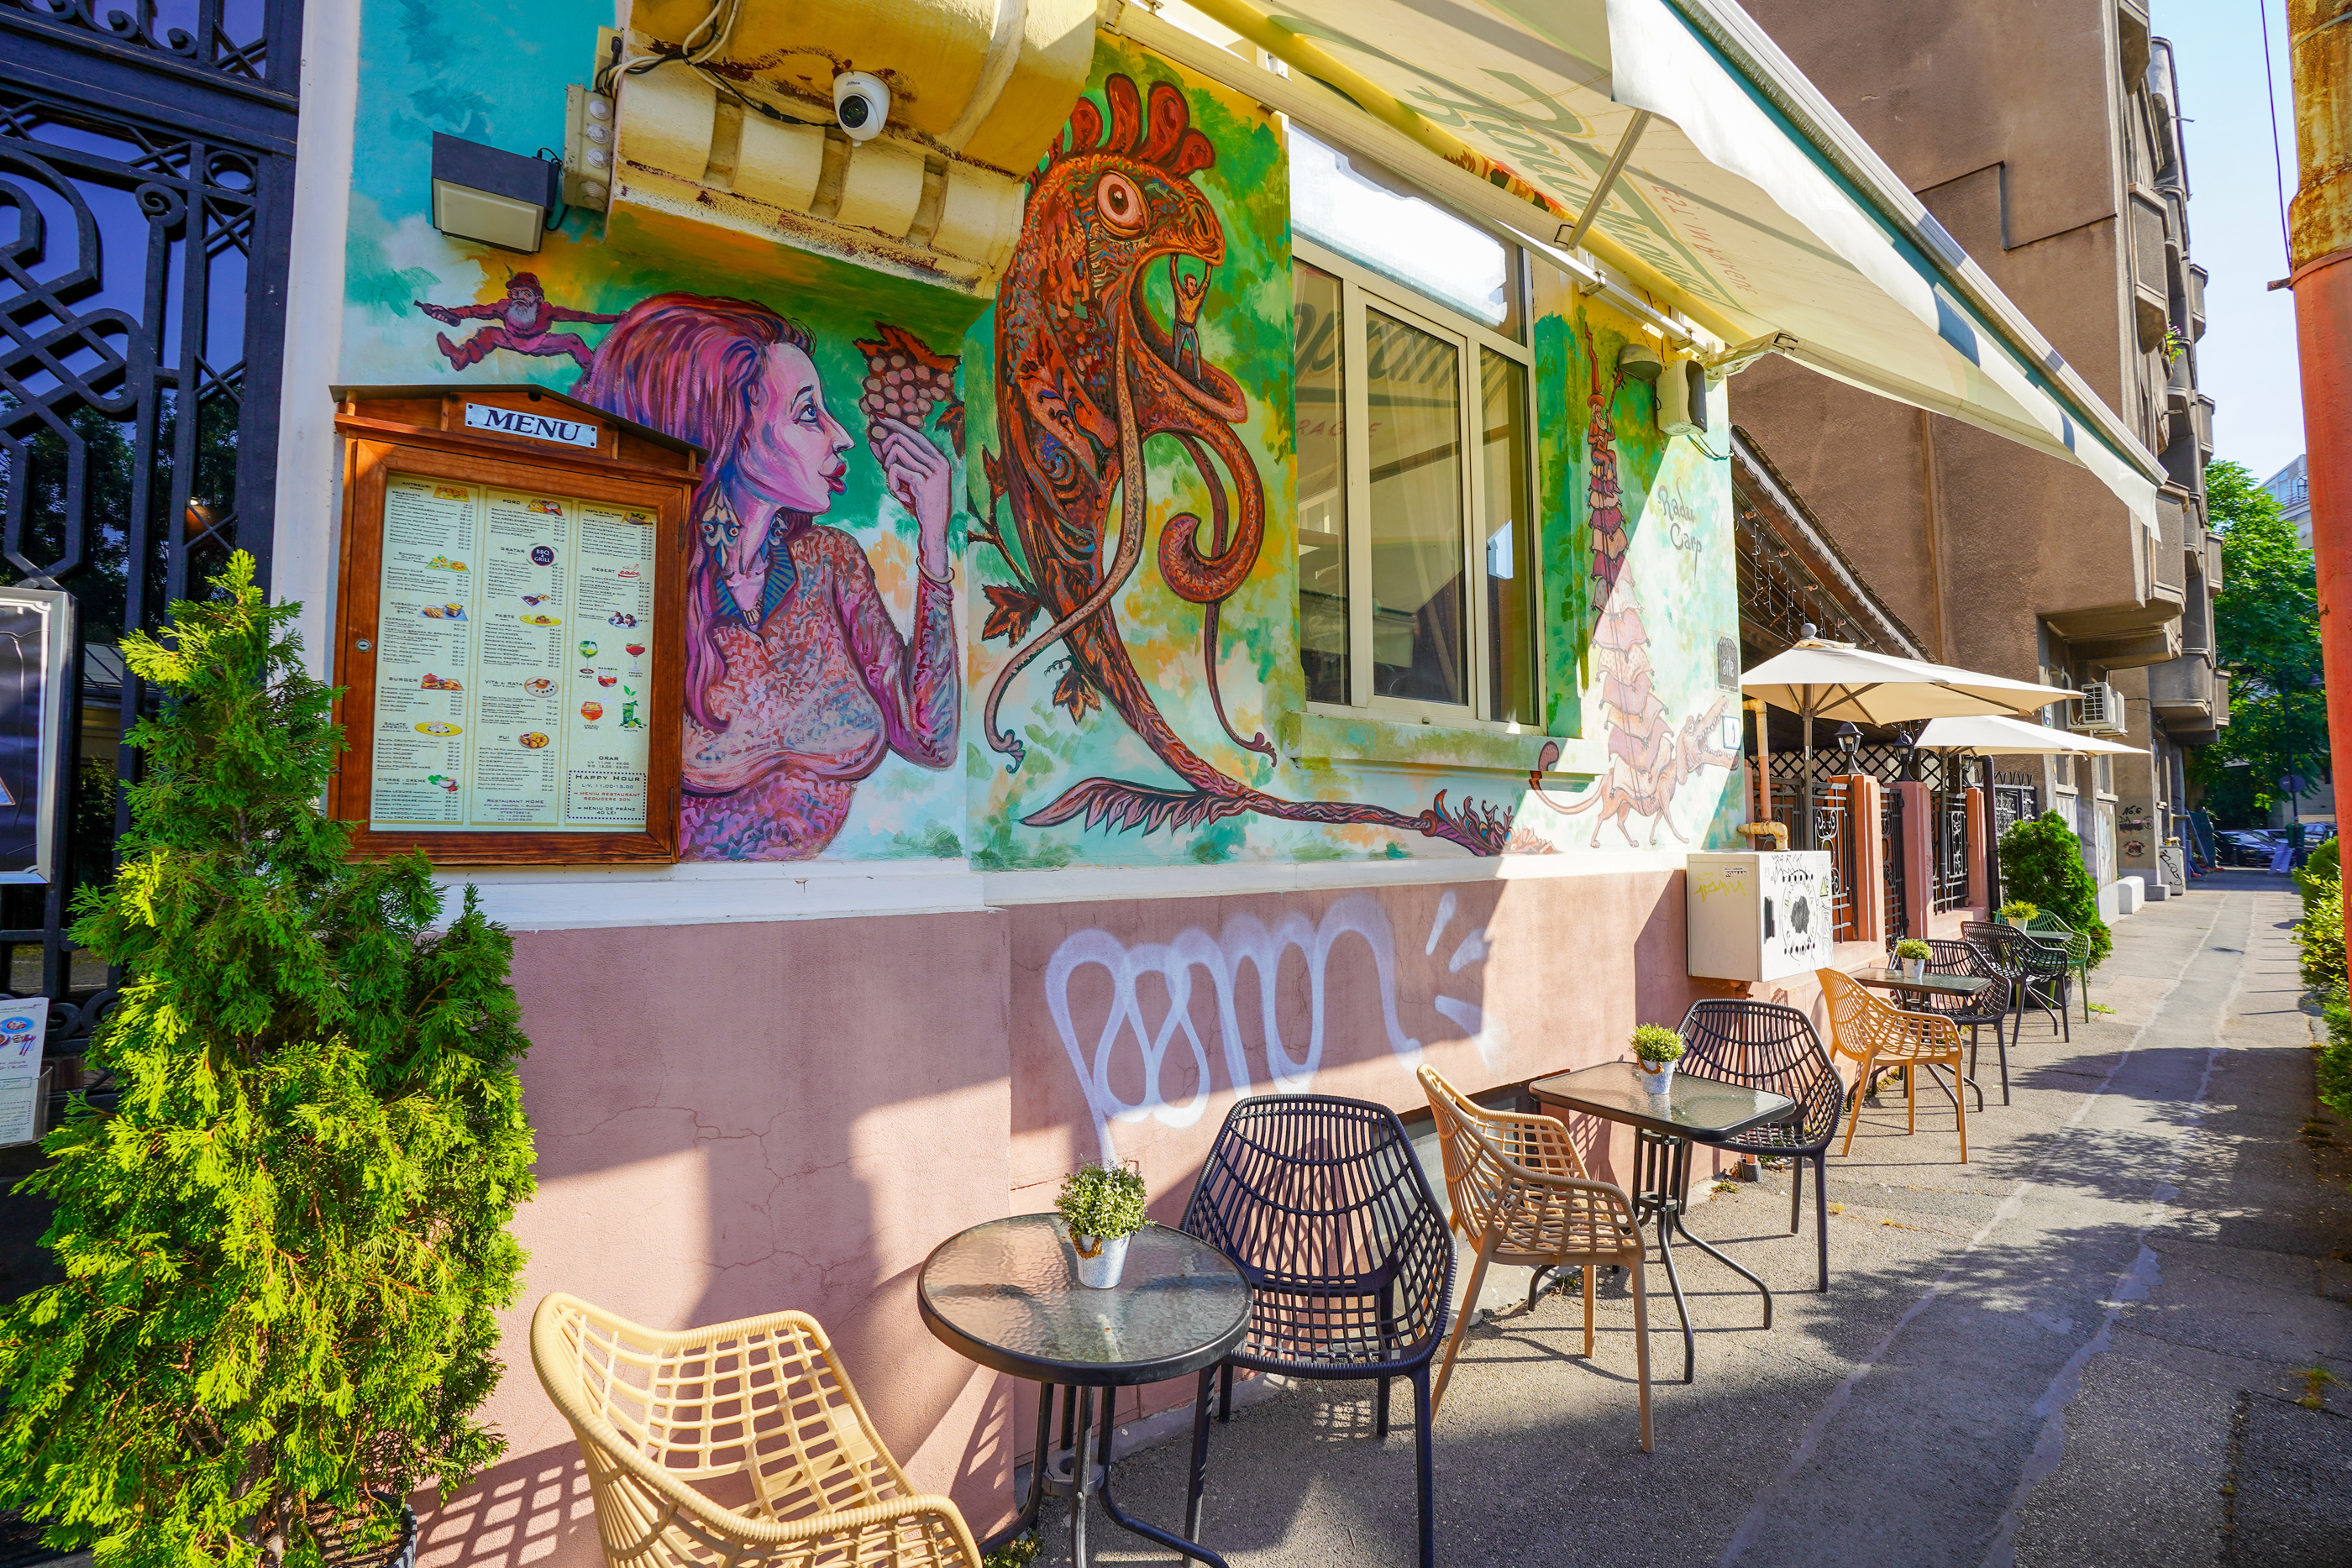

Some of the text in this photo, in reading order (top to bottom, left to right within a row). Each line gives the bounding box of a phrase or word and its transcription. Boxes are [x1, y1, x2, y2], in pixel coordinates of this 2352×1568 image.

[485, 410, 582, 442] MENU
[1658, 477, 1695, 522] Radu
[1670, 522, 1702, 581] Carp
[1722, 655, 1735, 678] arte
